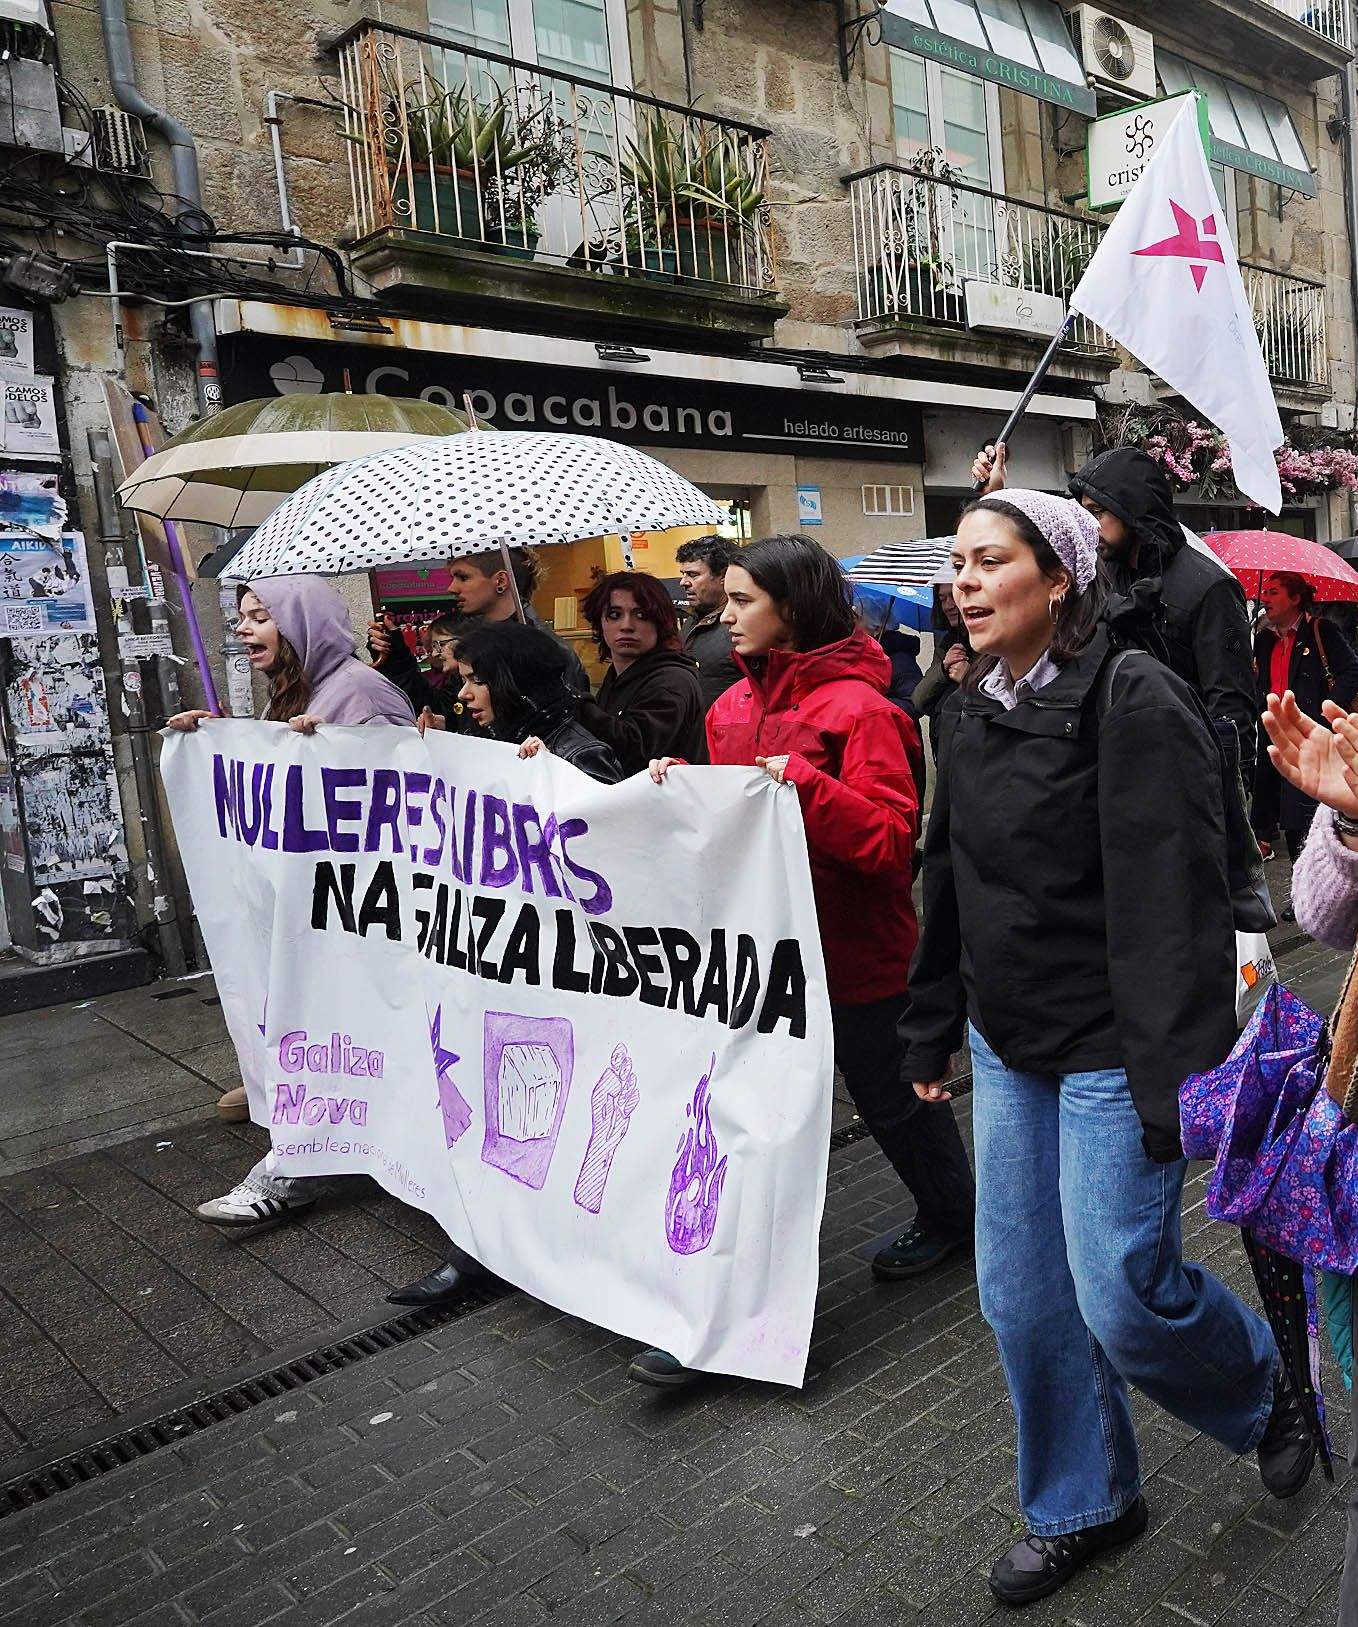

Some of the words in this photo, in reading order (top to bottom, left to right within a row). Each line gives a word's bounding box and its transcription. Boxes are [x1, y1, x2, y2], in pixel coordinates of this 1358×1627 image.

[912, 34, 978, 69] estética
[985, 56, 1074, 103] CRISTINA
[1245, 154, 1304, 187] CRISTINA
[5, 385, 47, 396] CAMOS
[365, 366, 733, 436] Copacabana
[783, 418, 839, 438] helado
[843, 425, 908, 443] artesano
[11, 540, 48, 551] AIKID
[213, 754, 447, 866] MULLERES
[450, 783, 613, 916] LIBRS
[311, 860, 402, 942] NA
[552, 908, 807, 1040] LIBERADA
[279, 1030, 384, 1078] Galiza
[272, 1084, 368, 1127] Nova
